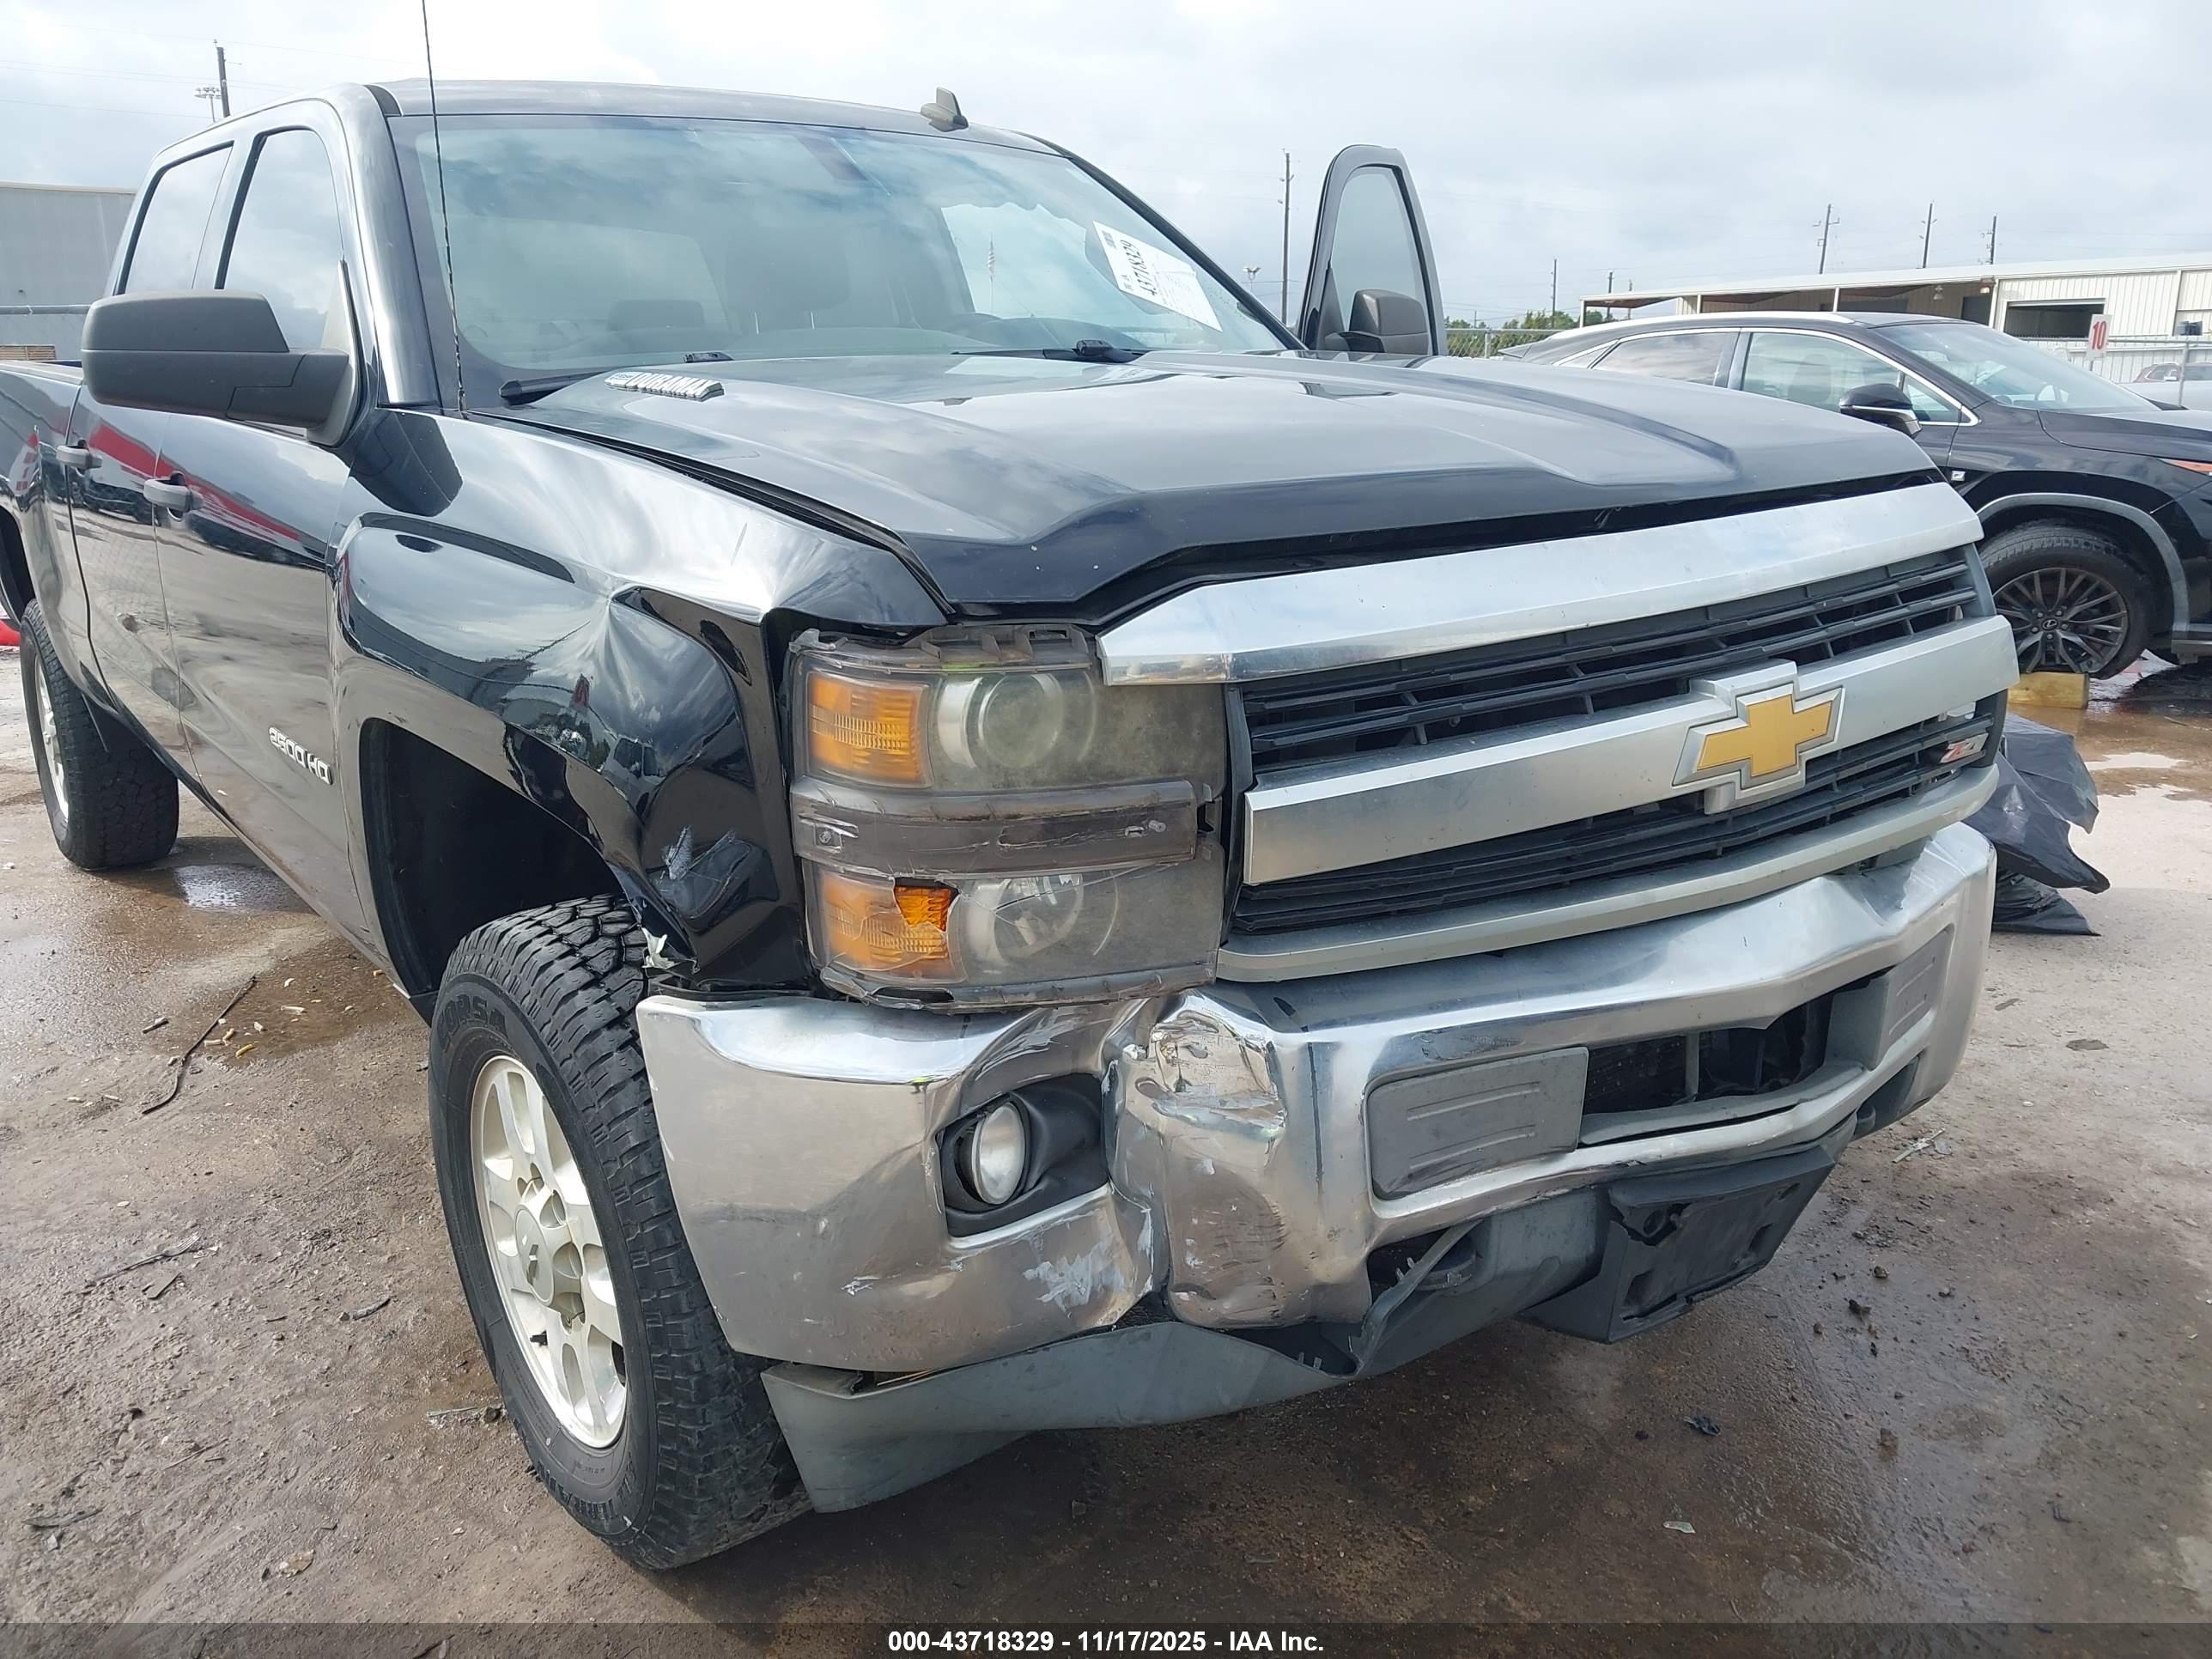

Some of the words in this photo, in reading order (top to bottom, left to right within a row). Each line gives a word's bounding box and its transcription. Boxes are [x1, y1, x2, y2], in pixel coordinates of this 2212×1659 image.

[2091, 320, 2107, 349] 10
[624, 372, 720, 400] DURAMAX
[269, 726, 307, 769] 2500
[307, 753, 332, 786] HD
